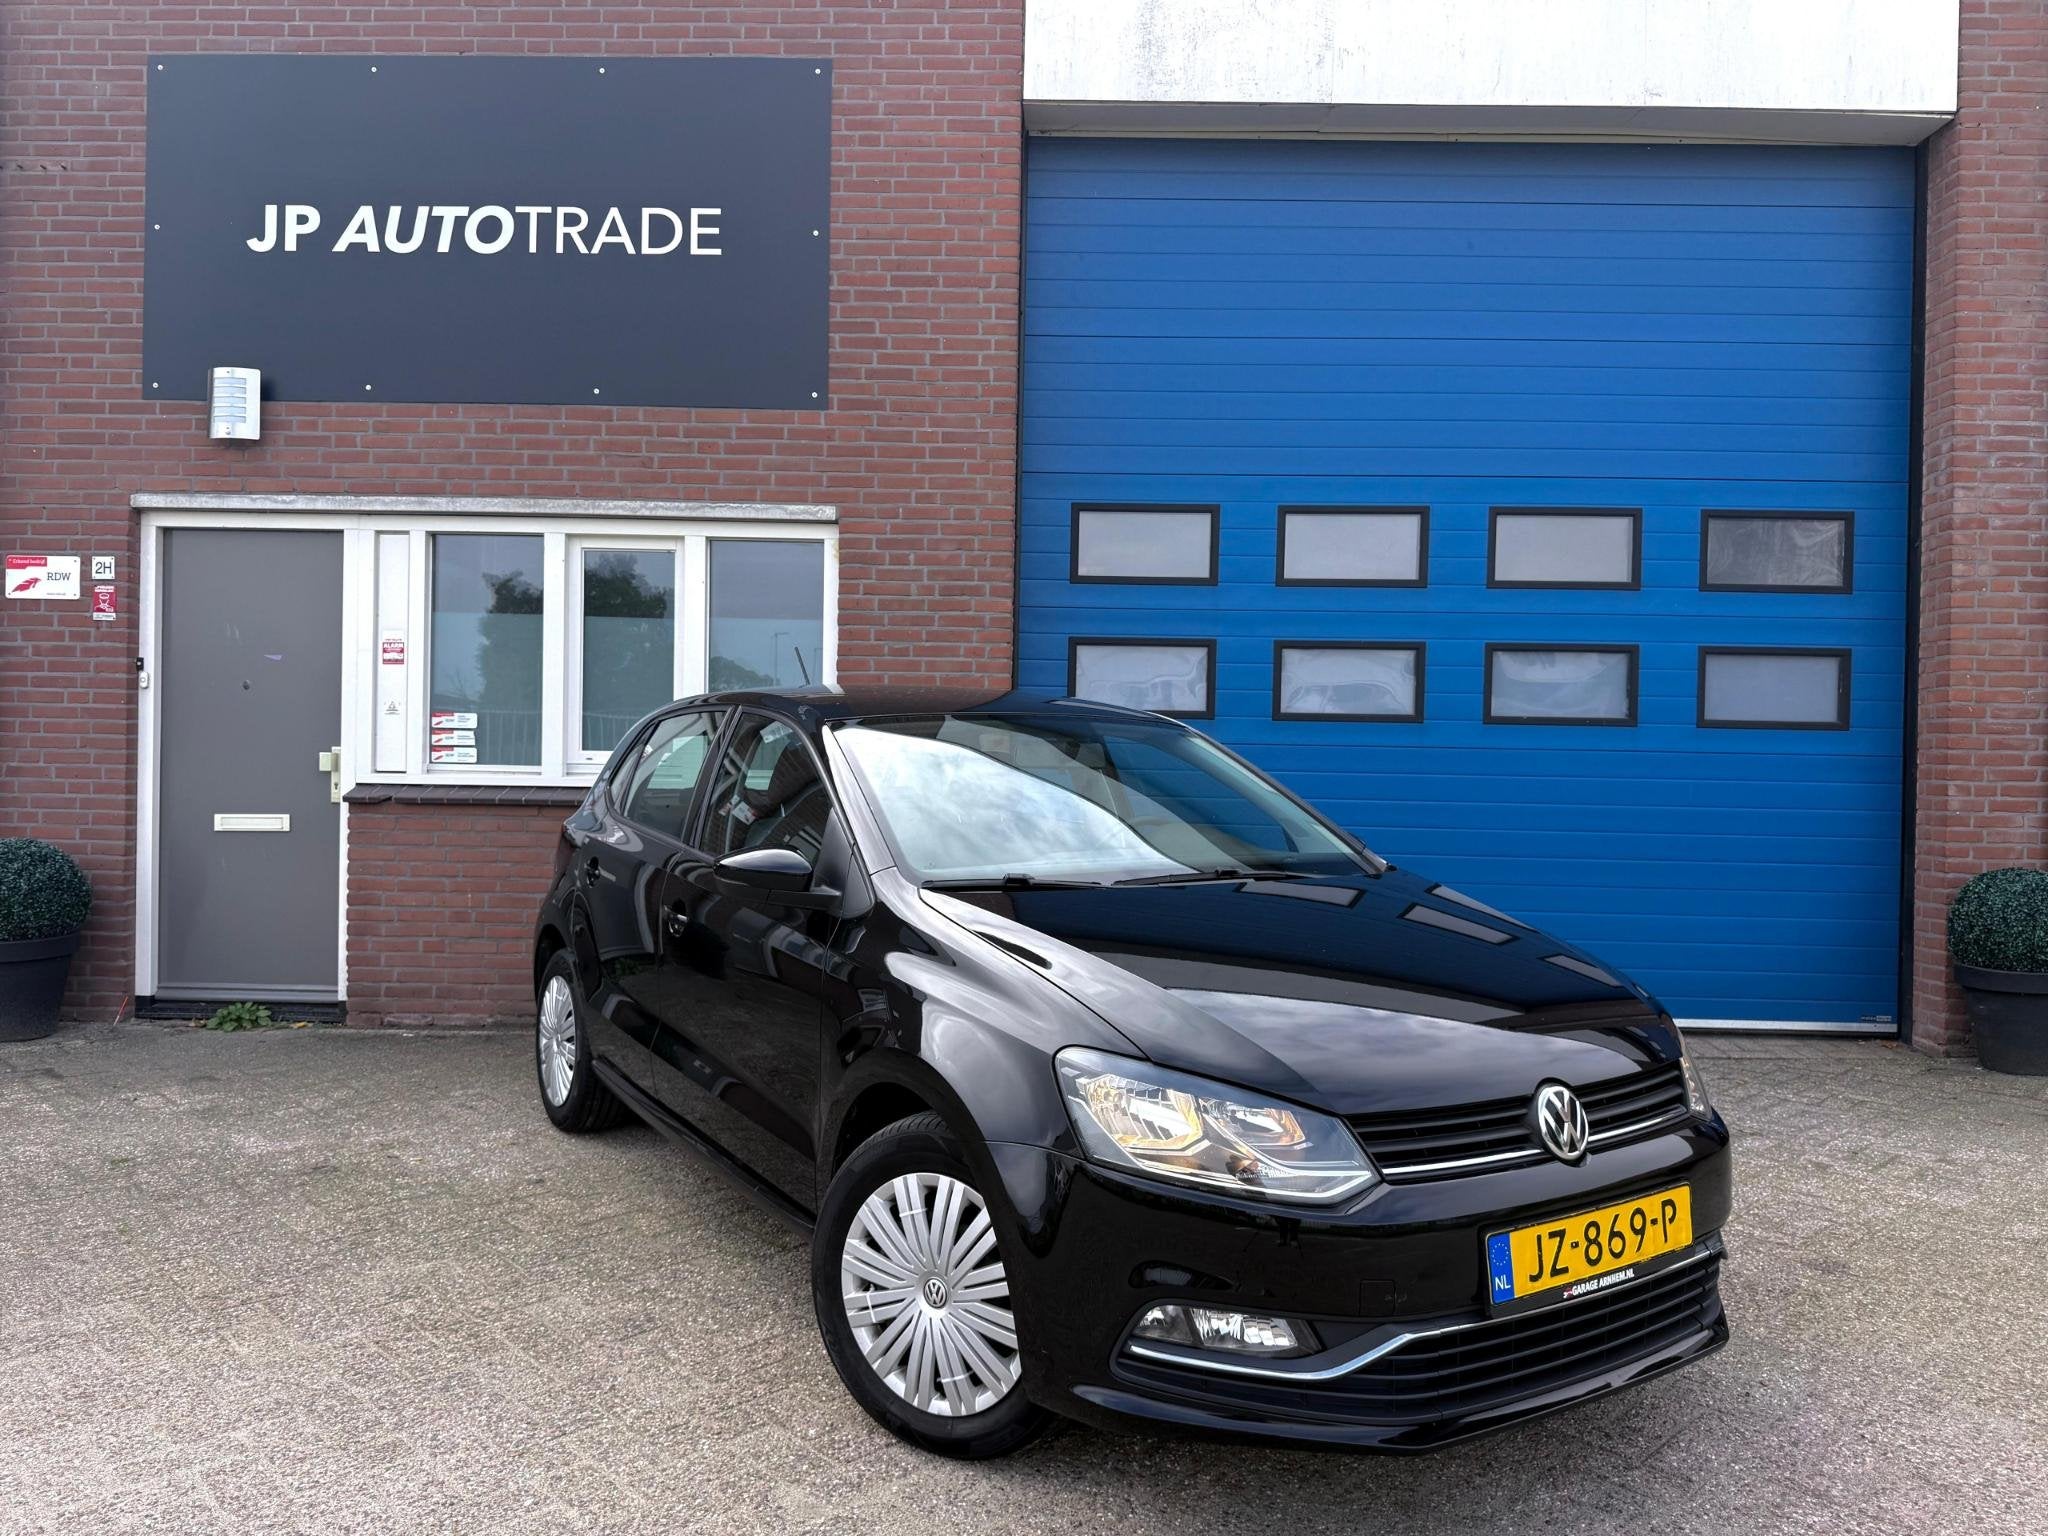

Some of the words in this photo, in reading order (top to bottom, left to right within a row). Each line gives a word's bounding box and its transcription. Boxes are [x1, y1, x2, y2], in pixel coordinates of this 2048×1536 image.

[246, 204, 321, 253] JP
[331, 204, 722, 256] AUTOTRADE
[95, 562, 112, 574] 2H
[47, 572, 71, 581] RDW
[1529, 1198, 1677, 1283] JZ-869-P
[1494, 1276, 1511, 1291] NL
[1572, 1279, 1599, 1296] GARAGE
